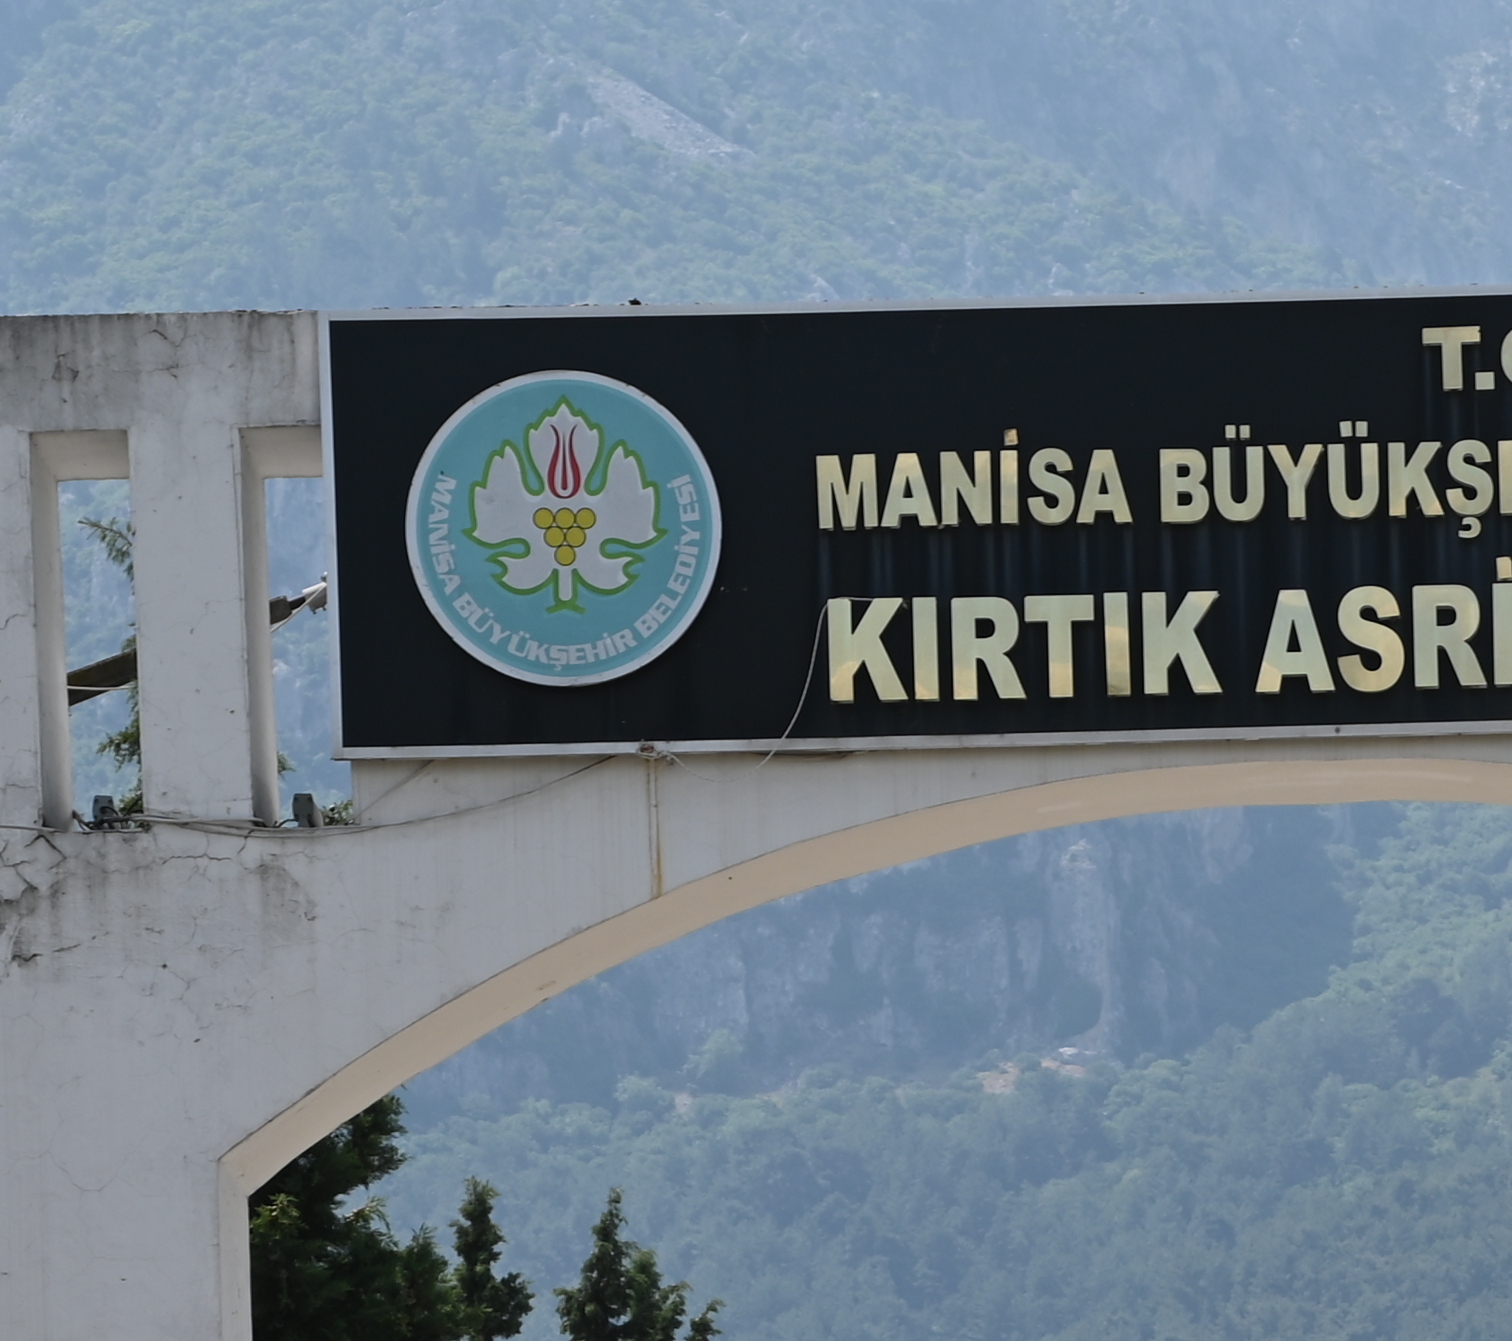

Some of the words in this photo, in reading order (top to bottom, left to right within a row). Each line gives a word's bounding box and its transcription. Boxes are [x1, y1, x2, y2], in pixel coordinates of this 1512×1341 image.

[815, 428, 1133, 531] MANİSA
[427, 474, 461, 596] MANİSA
[452, 593, 638, 671] BÜYÜKŞEHİR
[633, 474, 701, 638] BELEDİYESİ
[827, 590, 1224, 703] KIRTIK
